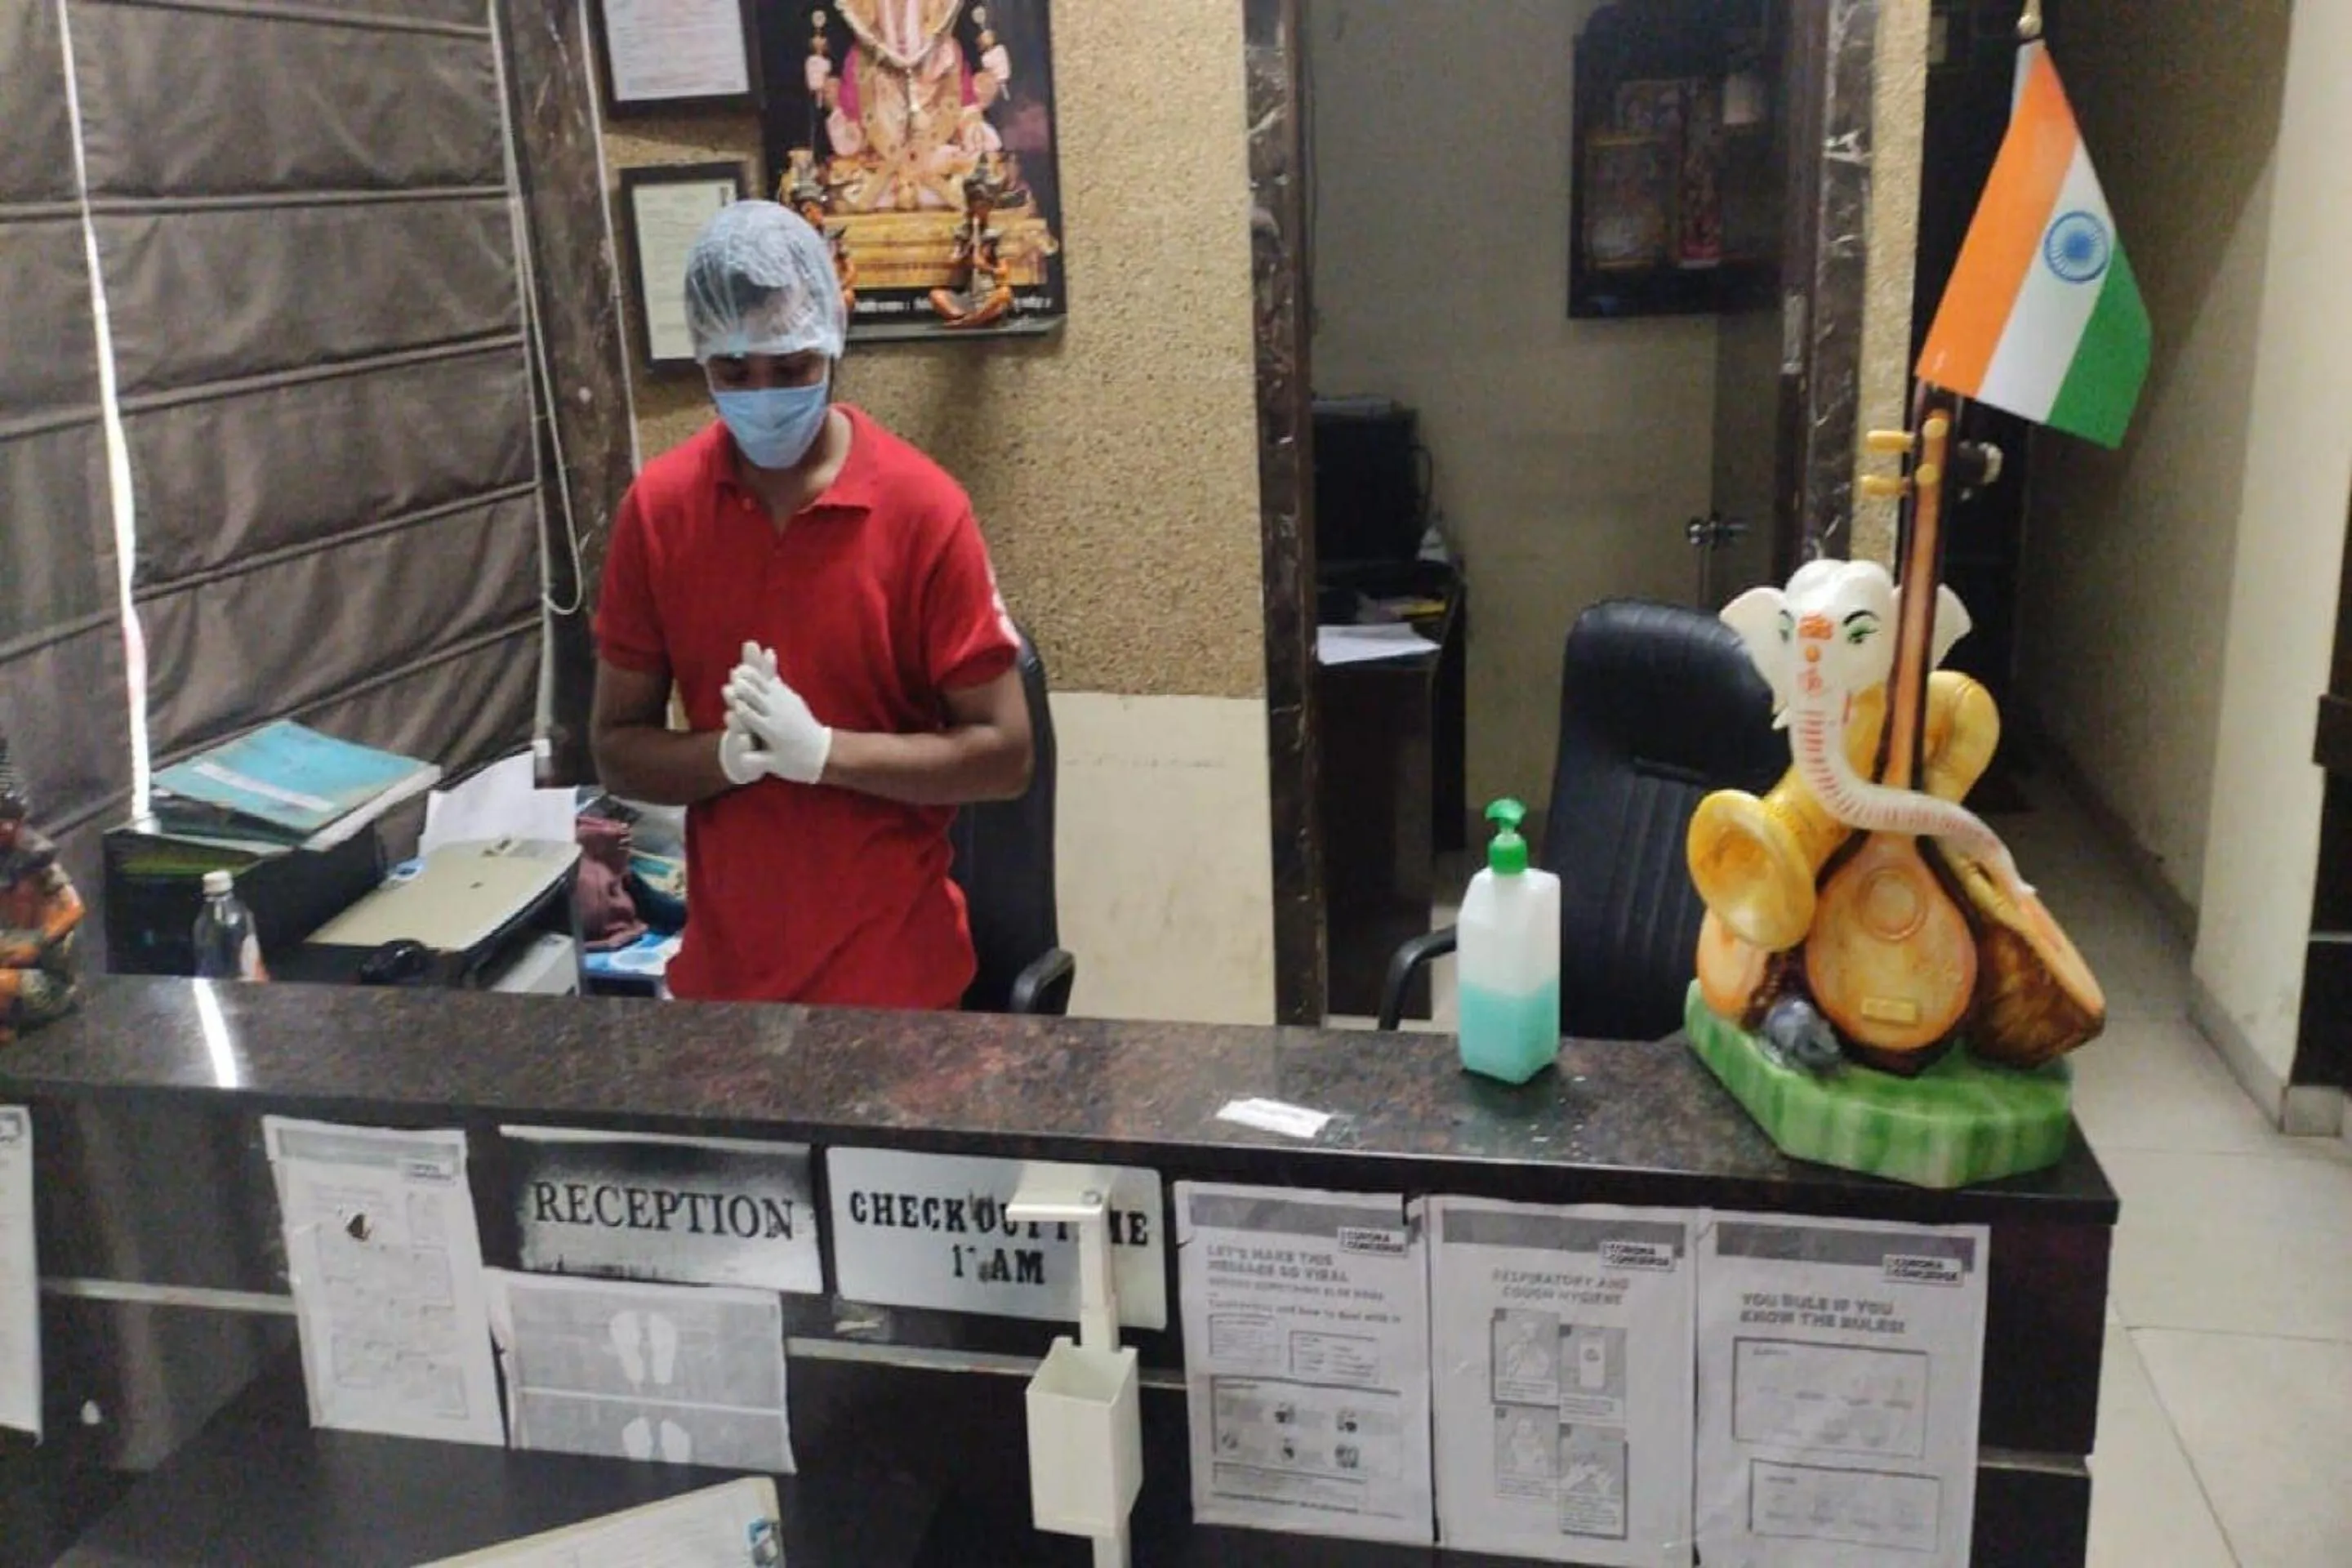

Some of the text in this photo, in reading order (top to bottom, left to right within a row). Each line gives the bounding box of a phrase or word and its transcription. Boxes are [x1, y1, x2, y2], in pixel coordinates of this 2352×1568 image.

[533, 1181, 794, 1240] RECEPTION
[849, 1191, 967, 1233] CHECK
[952, 1244, 1045, 1285] 1 AM
[1252, 1248, 1294, 1263] MAKE
[1492, 1267, 1630, 1290] RESPIRATORY AND
[1503, 1286, 1623, 1305] COUGH HYGIENE
[1743, 1293, 1778, 1307] YOU
[1781, 1293, 1829, 1311] RULE
[1855, 1300, 1895, 1316] YOU
[1740, 1310, 1795, 1323] KNOW
[1799, 1312, 1837, 1328] THE
